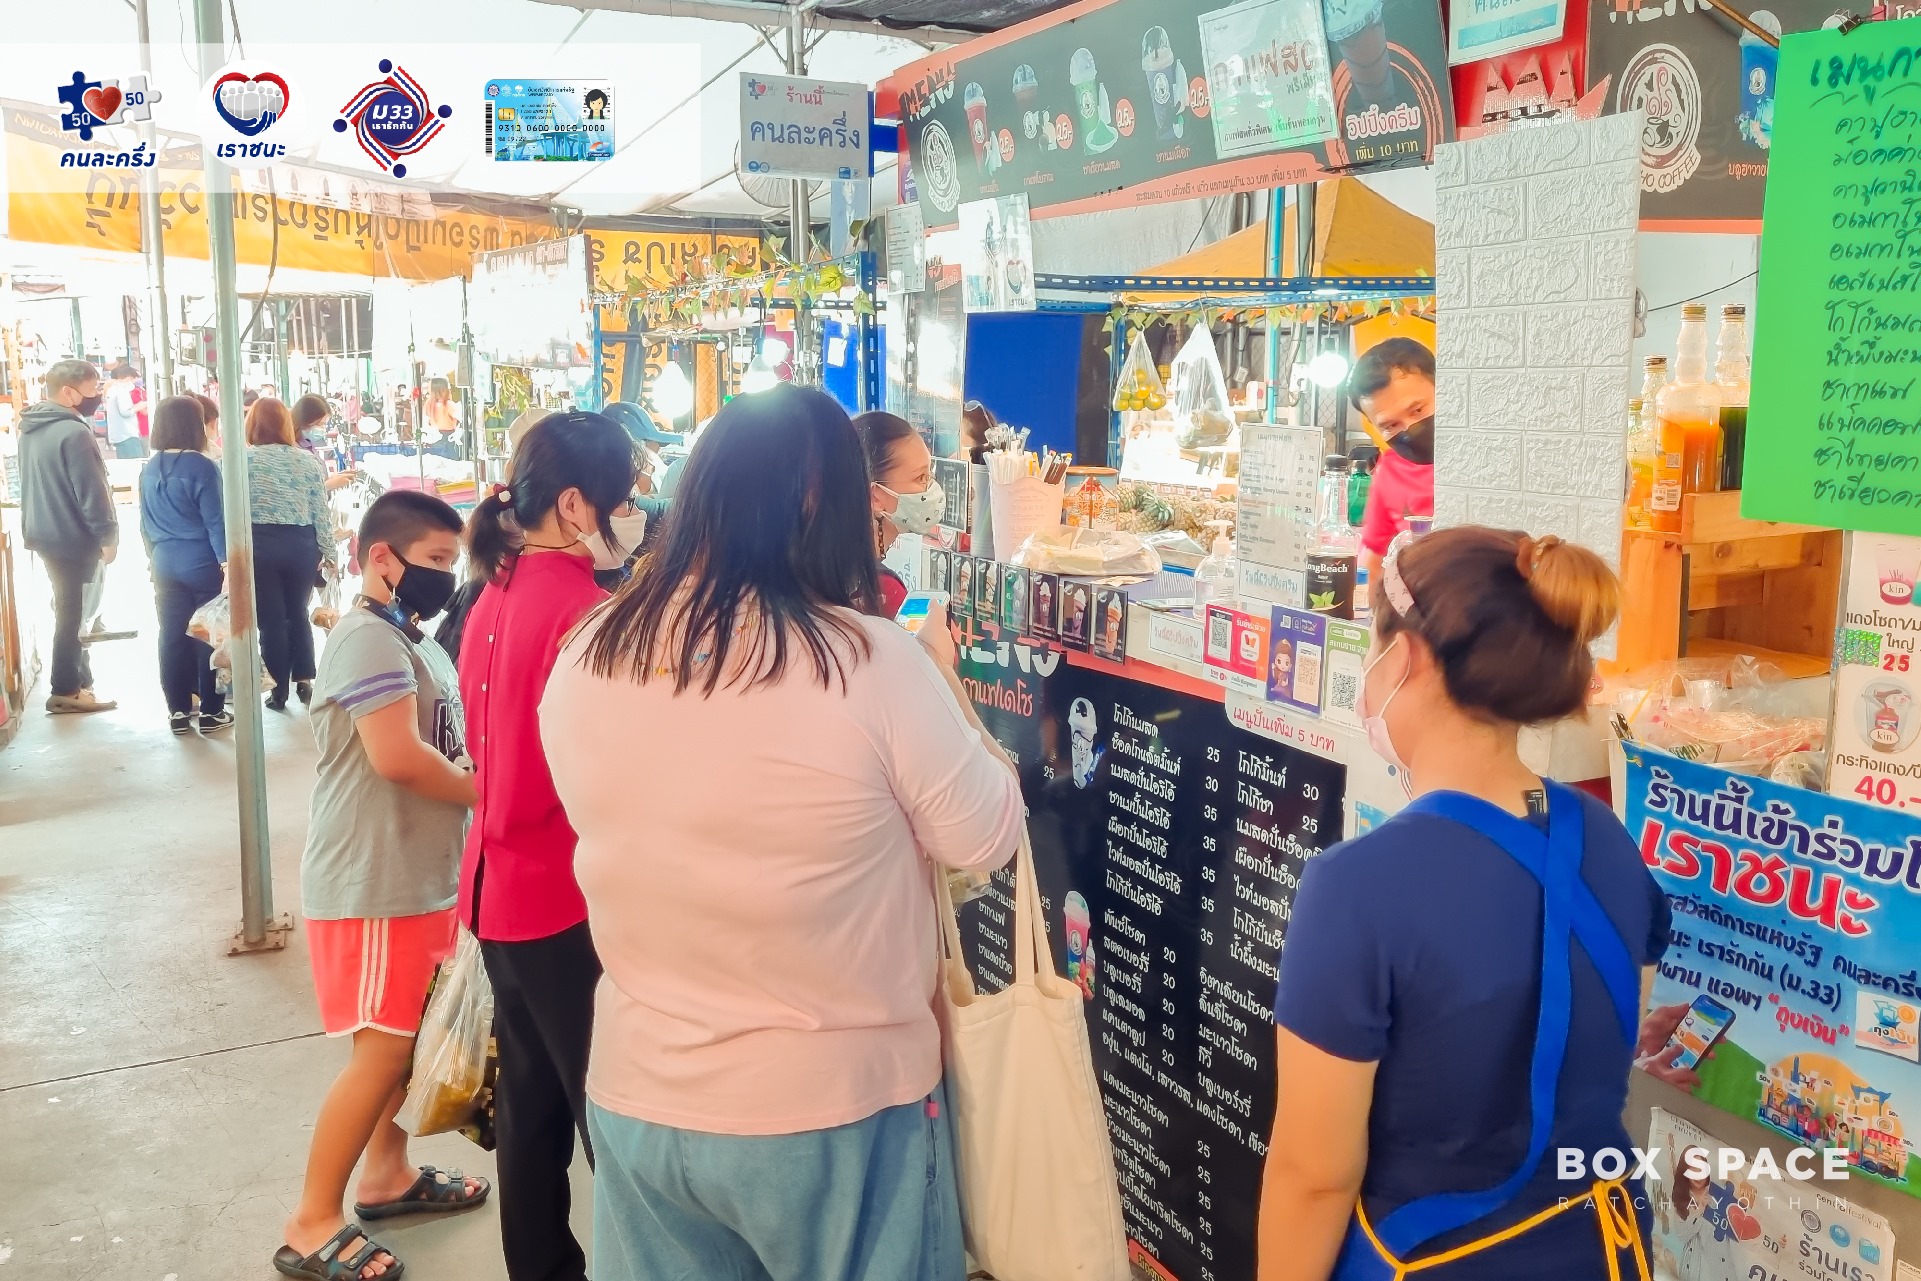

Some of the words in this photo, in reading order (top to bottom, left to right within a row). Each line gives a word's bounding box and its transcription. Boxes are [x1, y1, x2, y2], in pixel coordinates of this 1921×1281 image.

[786, 85, 824, 105] ร้านนี้
[750, 111, 862, 150] คนละครึ่ง
[1355, 141, 1375, 160] เพิ่ม
[1380, 146, 1392, 157] 10
[1397, 140, 1419, 155] บาท
[1657, 152, 1698, 189] COFFEE
[1888, 584, 1904, 594] kin
[1882, 653, 1911, 672] 25
[1113, 702, 1159, 738] โกโก้นมสด
[1206, 746, 1221, 762] 25
[1233, 706, 1293, 740] เมนูปั่นเพิ่ม
[1297, 729, 1306, 742] 5
[1310, 733, 1335, 753] บาท
[1876, 731, 1893, 742] kin
[1044, 765, 1055, 780] 25
[1238, 750, 1287, 789] โกโก้มิ้นท์
[1303, 782, 1320, 801] 30
[1205, 776, 1219, 792] 30
[1204, 804, 1218, 821] 35
[1237, 781, 1274, 816] โกโก้ชา
[1301, 816, 1318, 834] 25
[1202, 836, 1216, 852] 35
[1201, 866, 1216, 883] 35
[1640, 819, 1876, 936] เราชนะ
[1200, 896, 1215, 913] 35
[1200, 927, 1214, 946] 35
[1163, 946, 1176, 964] 20
[1162, 972, 1176, 990] 20
[1698, 937, 1774, 982] เรารักกัน
[1780, 963, 1842, 1013] (ม.33)
[1200, 966, 1275, 1025] อิตาเลียนโซดา
[1707, 976, 1763, 1011] แอพฯ
[1162, 998, 1176, 1015] 20
[1199, 988, 1248, 1037] ลิ้นจี่โซดา
[1102, 1007, 1146, 1047] แคนตาลูป
[1161, 1049, 1175, 1067] 20
[1162, 1023, 1175, 1041] 20
[1198, 1023, 1258, 1071] มะนาวโซดา
[1197, 1140, 1211, 1158] 25
[1197, 1165, 1211, 1184] 25
[1198, 1190, 1211, 1210] 25
[1199, 1216, 1212, 1236] 25
[1712, 1212, 1729, 1231] 50
[1200, 1241, 1213, 1261] 25
[1762, 1234, 1780, 1255] 50
